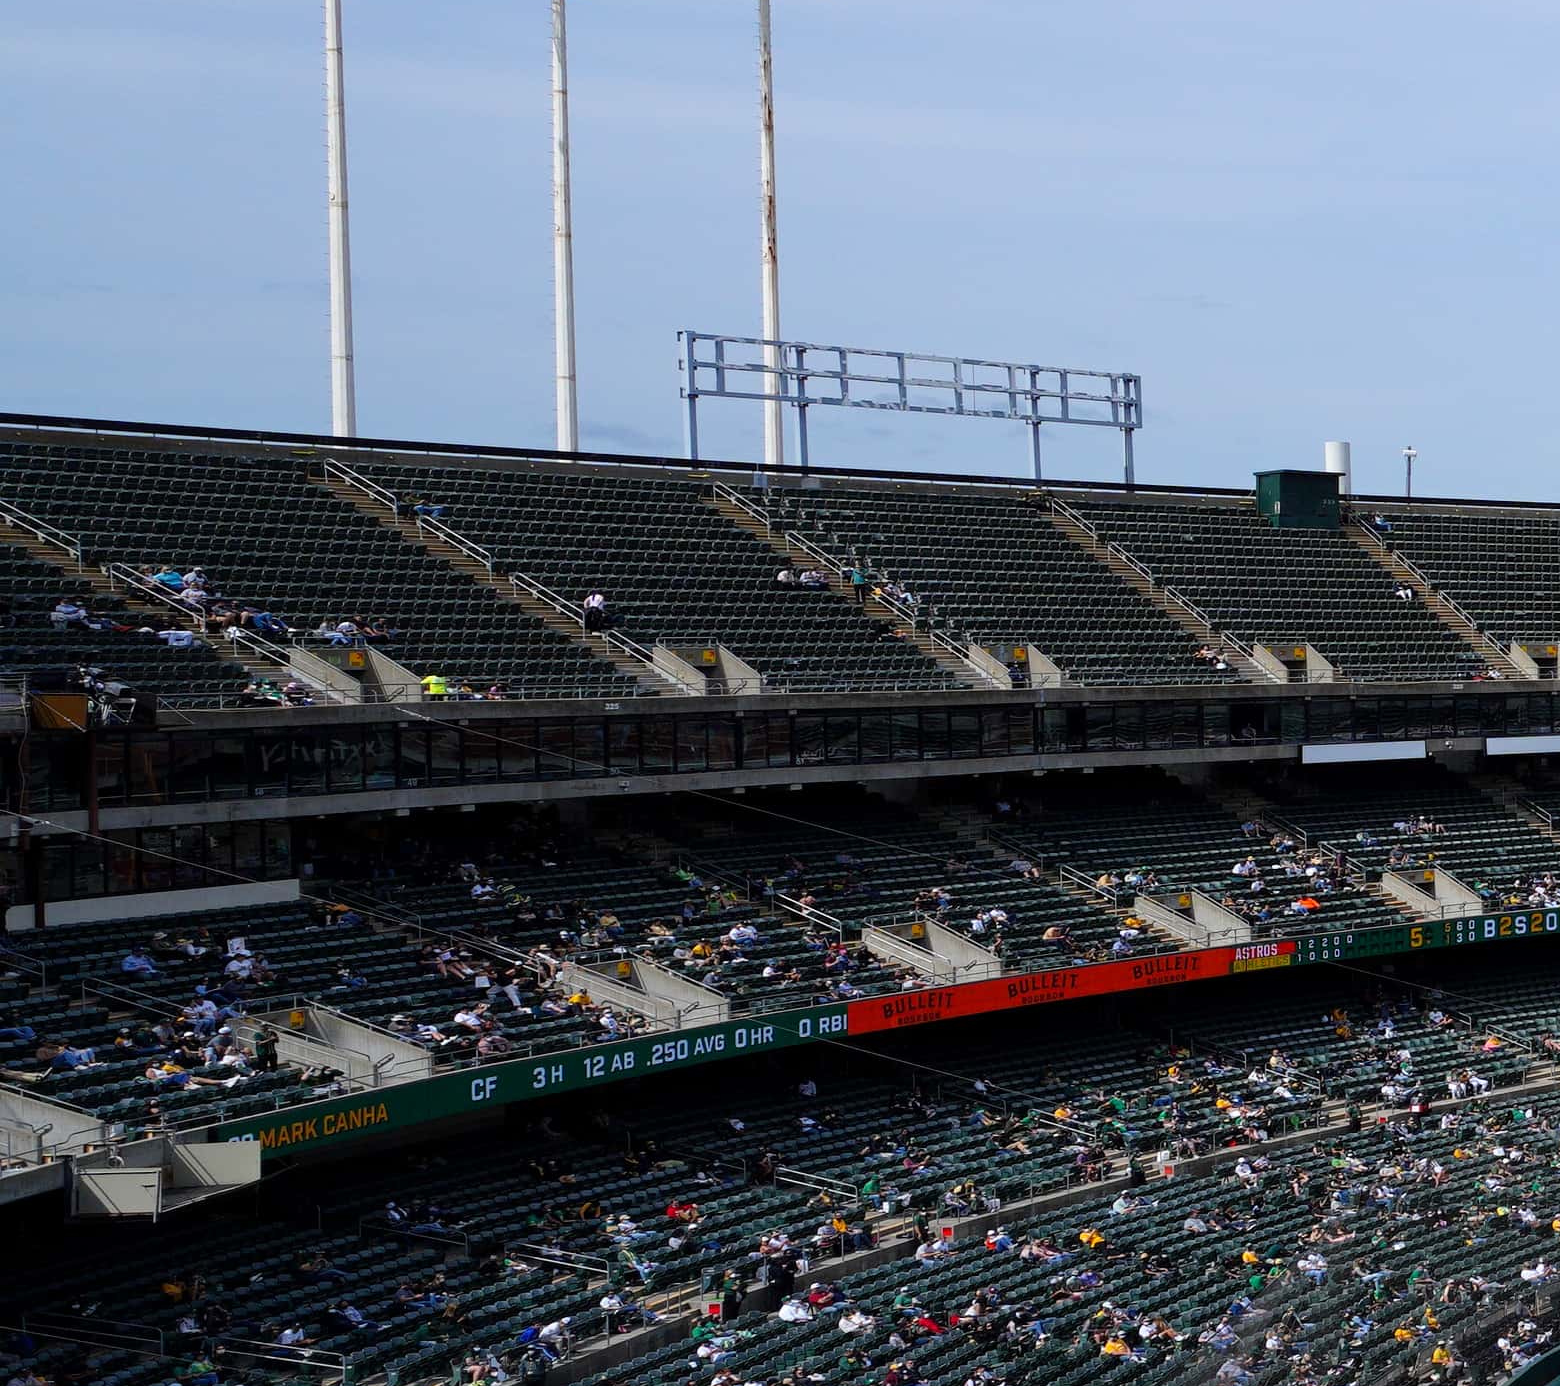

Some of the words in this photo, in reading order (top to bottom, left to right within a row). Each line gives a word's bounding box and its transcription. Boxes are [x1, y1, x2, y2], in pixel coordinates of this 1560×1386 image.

[1235, 943, 1278, 960] ASTROS
[1007, 973, 1079, 998] BULLEIT
[882, 992, 953, 1019] BULLEIT
[258, 1116, 317, 1150] MARK
[322, 1102, 388, 1137] CANHA
[470, 1076, 497, 1101] CF
[647, 1039, 689, 1067] .250
[693, 1034, 725, 1056] AVG
